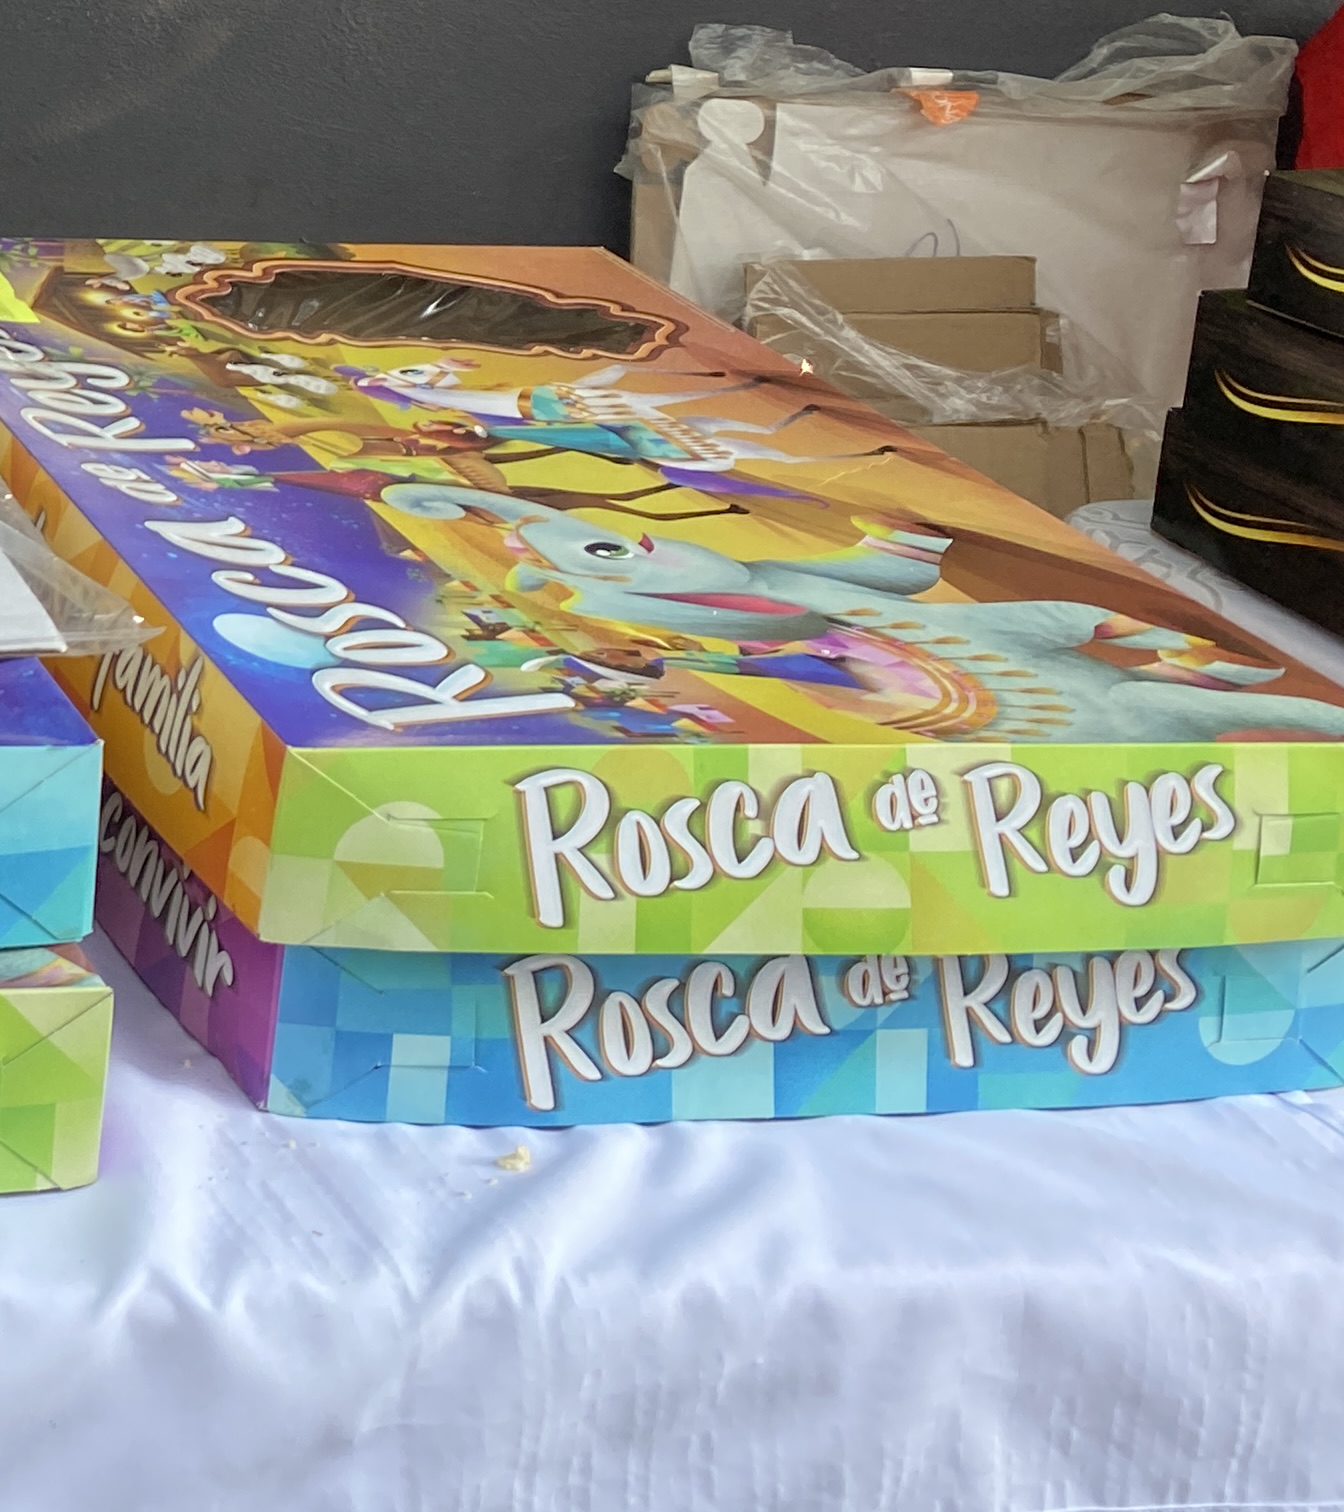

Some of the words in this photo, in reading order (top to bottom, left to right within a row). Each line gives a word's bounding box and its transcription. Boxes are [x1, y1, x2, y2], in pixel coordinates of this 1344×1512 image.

[80, 462, 181, 505] de
[144, 514, 579, 731] Rosca
[513, 766, 861, 929] Rosca
[872, 768, 939, 831] de
[961, 762, 1238, 907] Reyes
[505, 953, 832, 1112] Rosca
[847, 953, 911, 1008] de
[937, 948, 1200, 1075] Reyes
